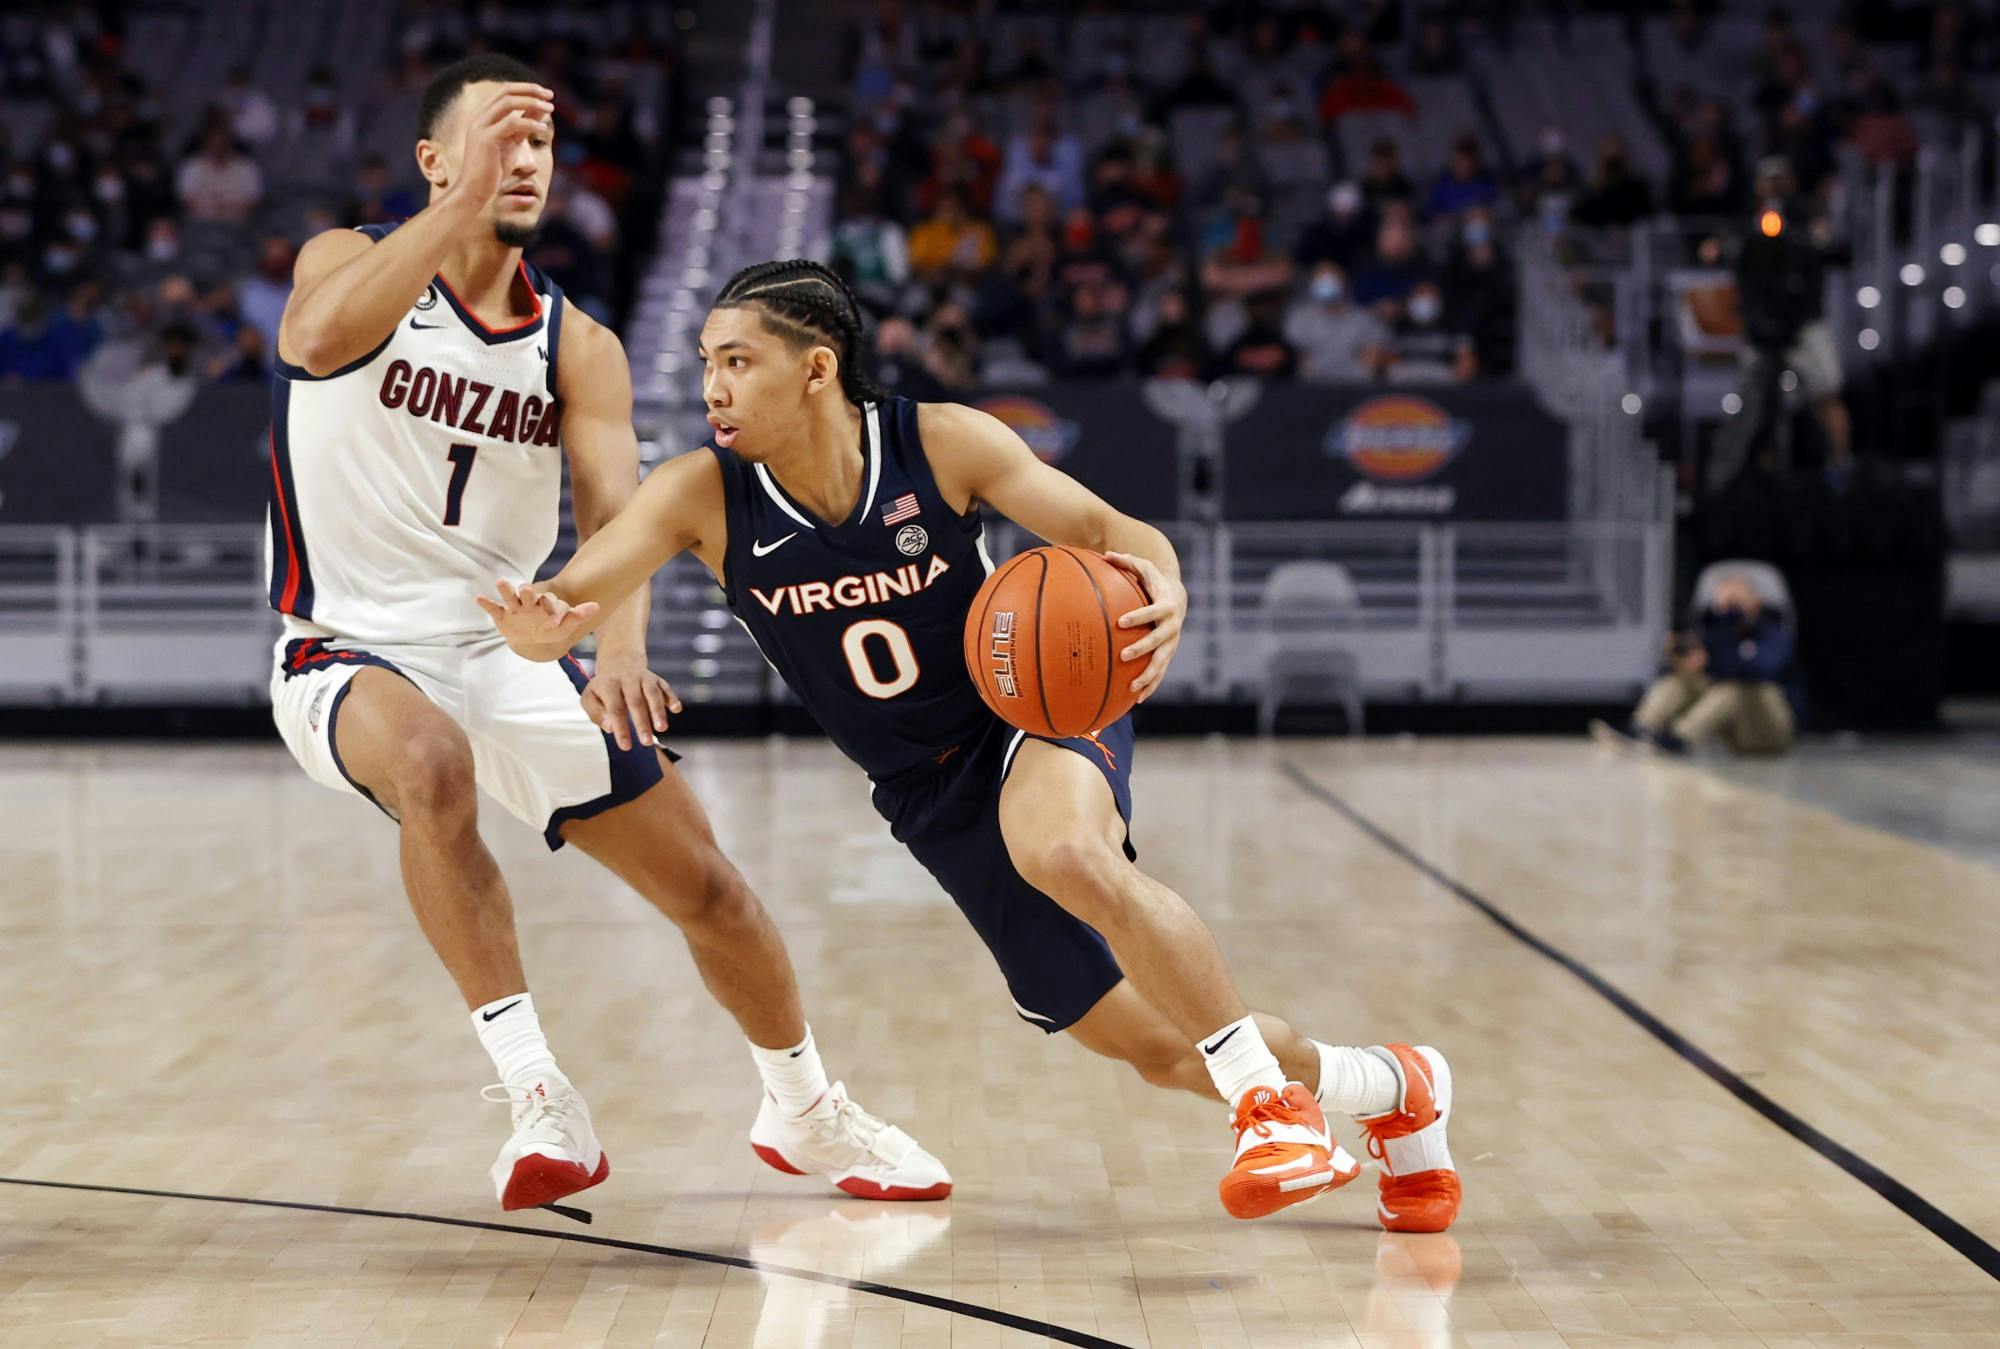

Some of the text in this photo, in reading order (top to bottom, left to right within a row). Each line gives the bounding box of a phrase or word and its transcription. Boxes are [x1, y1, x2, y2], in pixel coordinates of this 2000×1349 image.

[379, 359, 561, 448] GONZAGA
[443, 443, 478, 527] 1
[902, 532, 924, 546] ACC
[749, 554, 951, 617] VIRGINIA
[841, 618, 922, 700] 0
[991, 611, 1018, 698] ELITE
